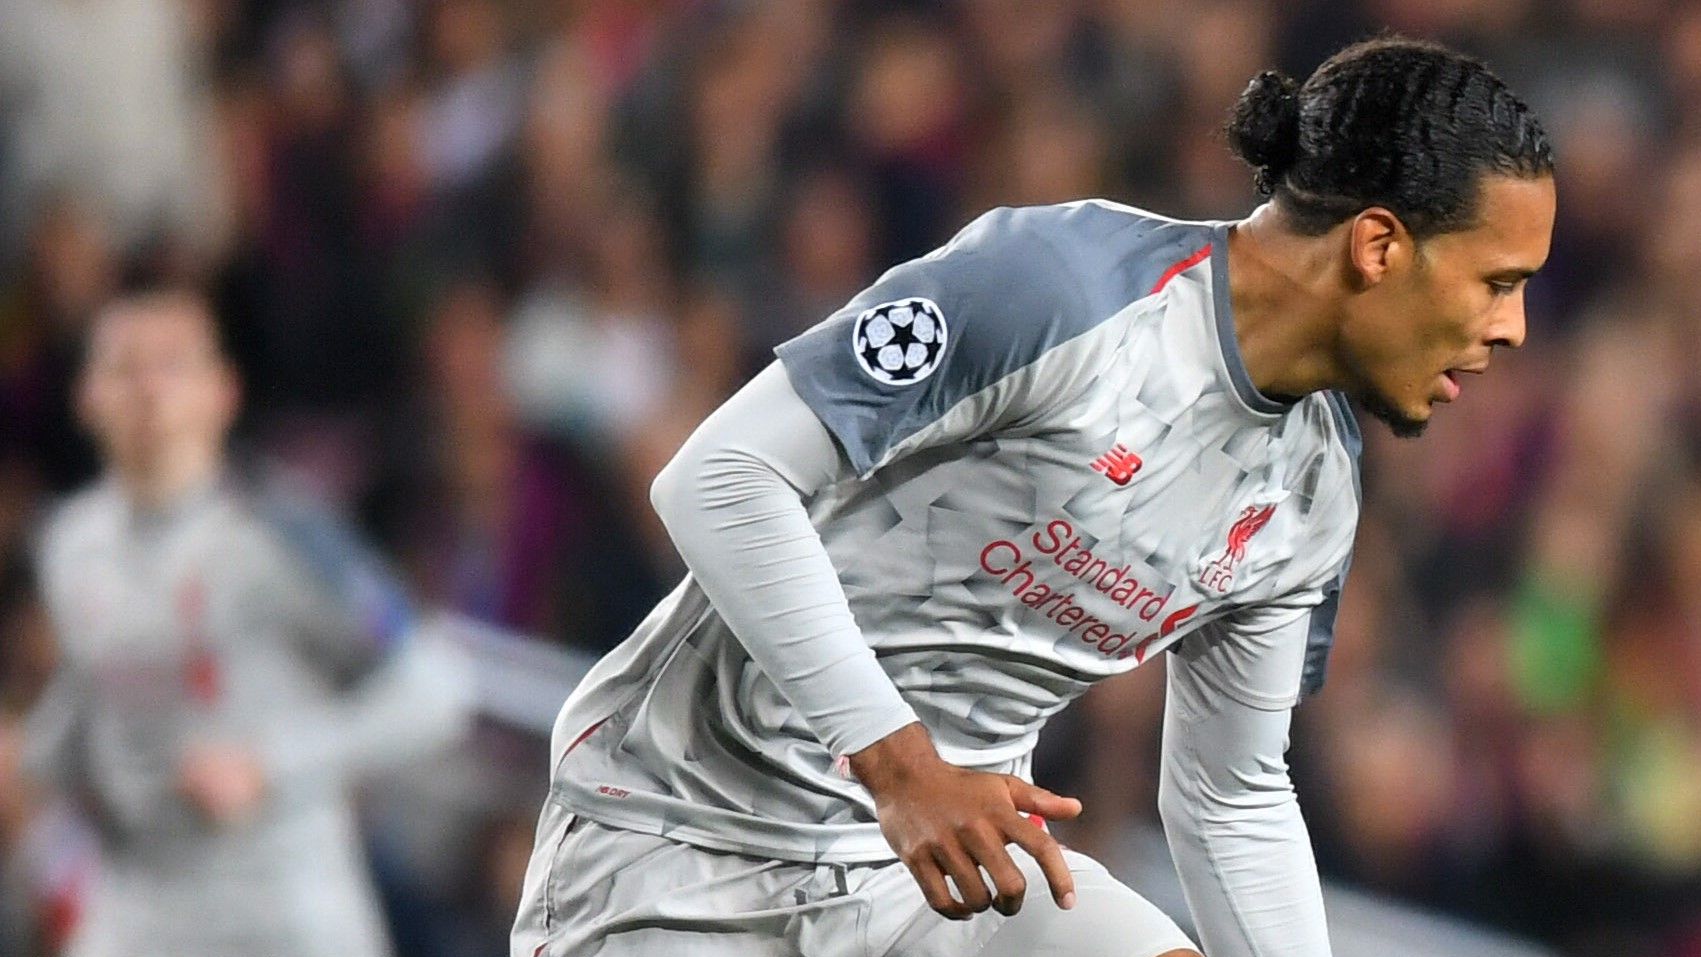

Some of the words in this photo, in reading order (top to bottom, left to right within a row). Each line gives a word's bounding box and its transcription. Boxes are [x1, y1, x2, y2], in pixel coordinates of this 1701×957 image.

[979, 540, 1138, 657] Chartered
[1032, 520, 1176, 623] Standard
[1199, 566, 1233, 593] LFC
